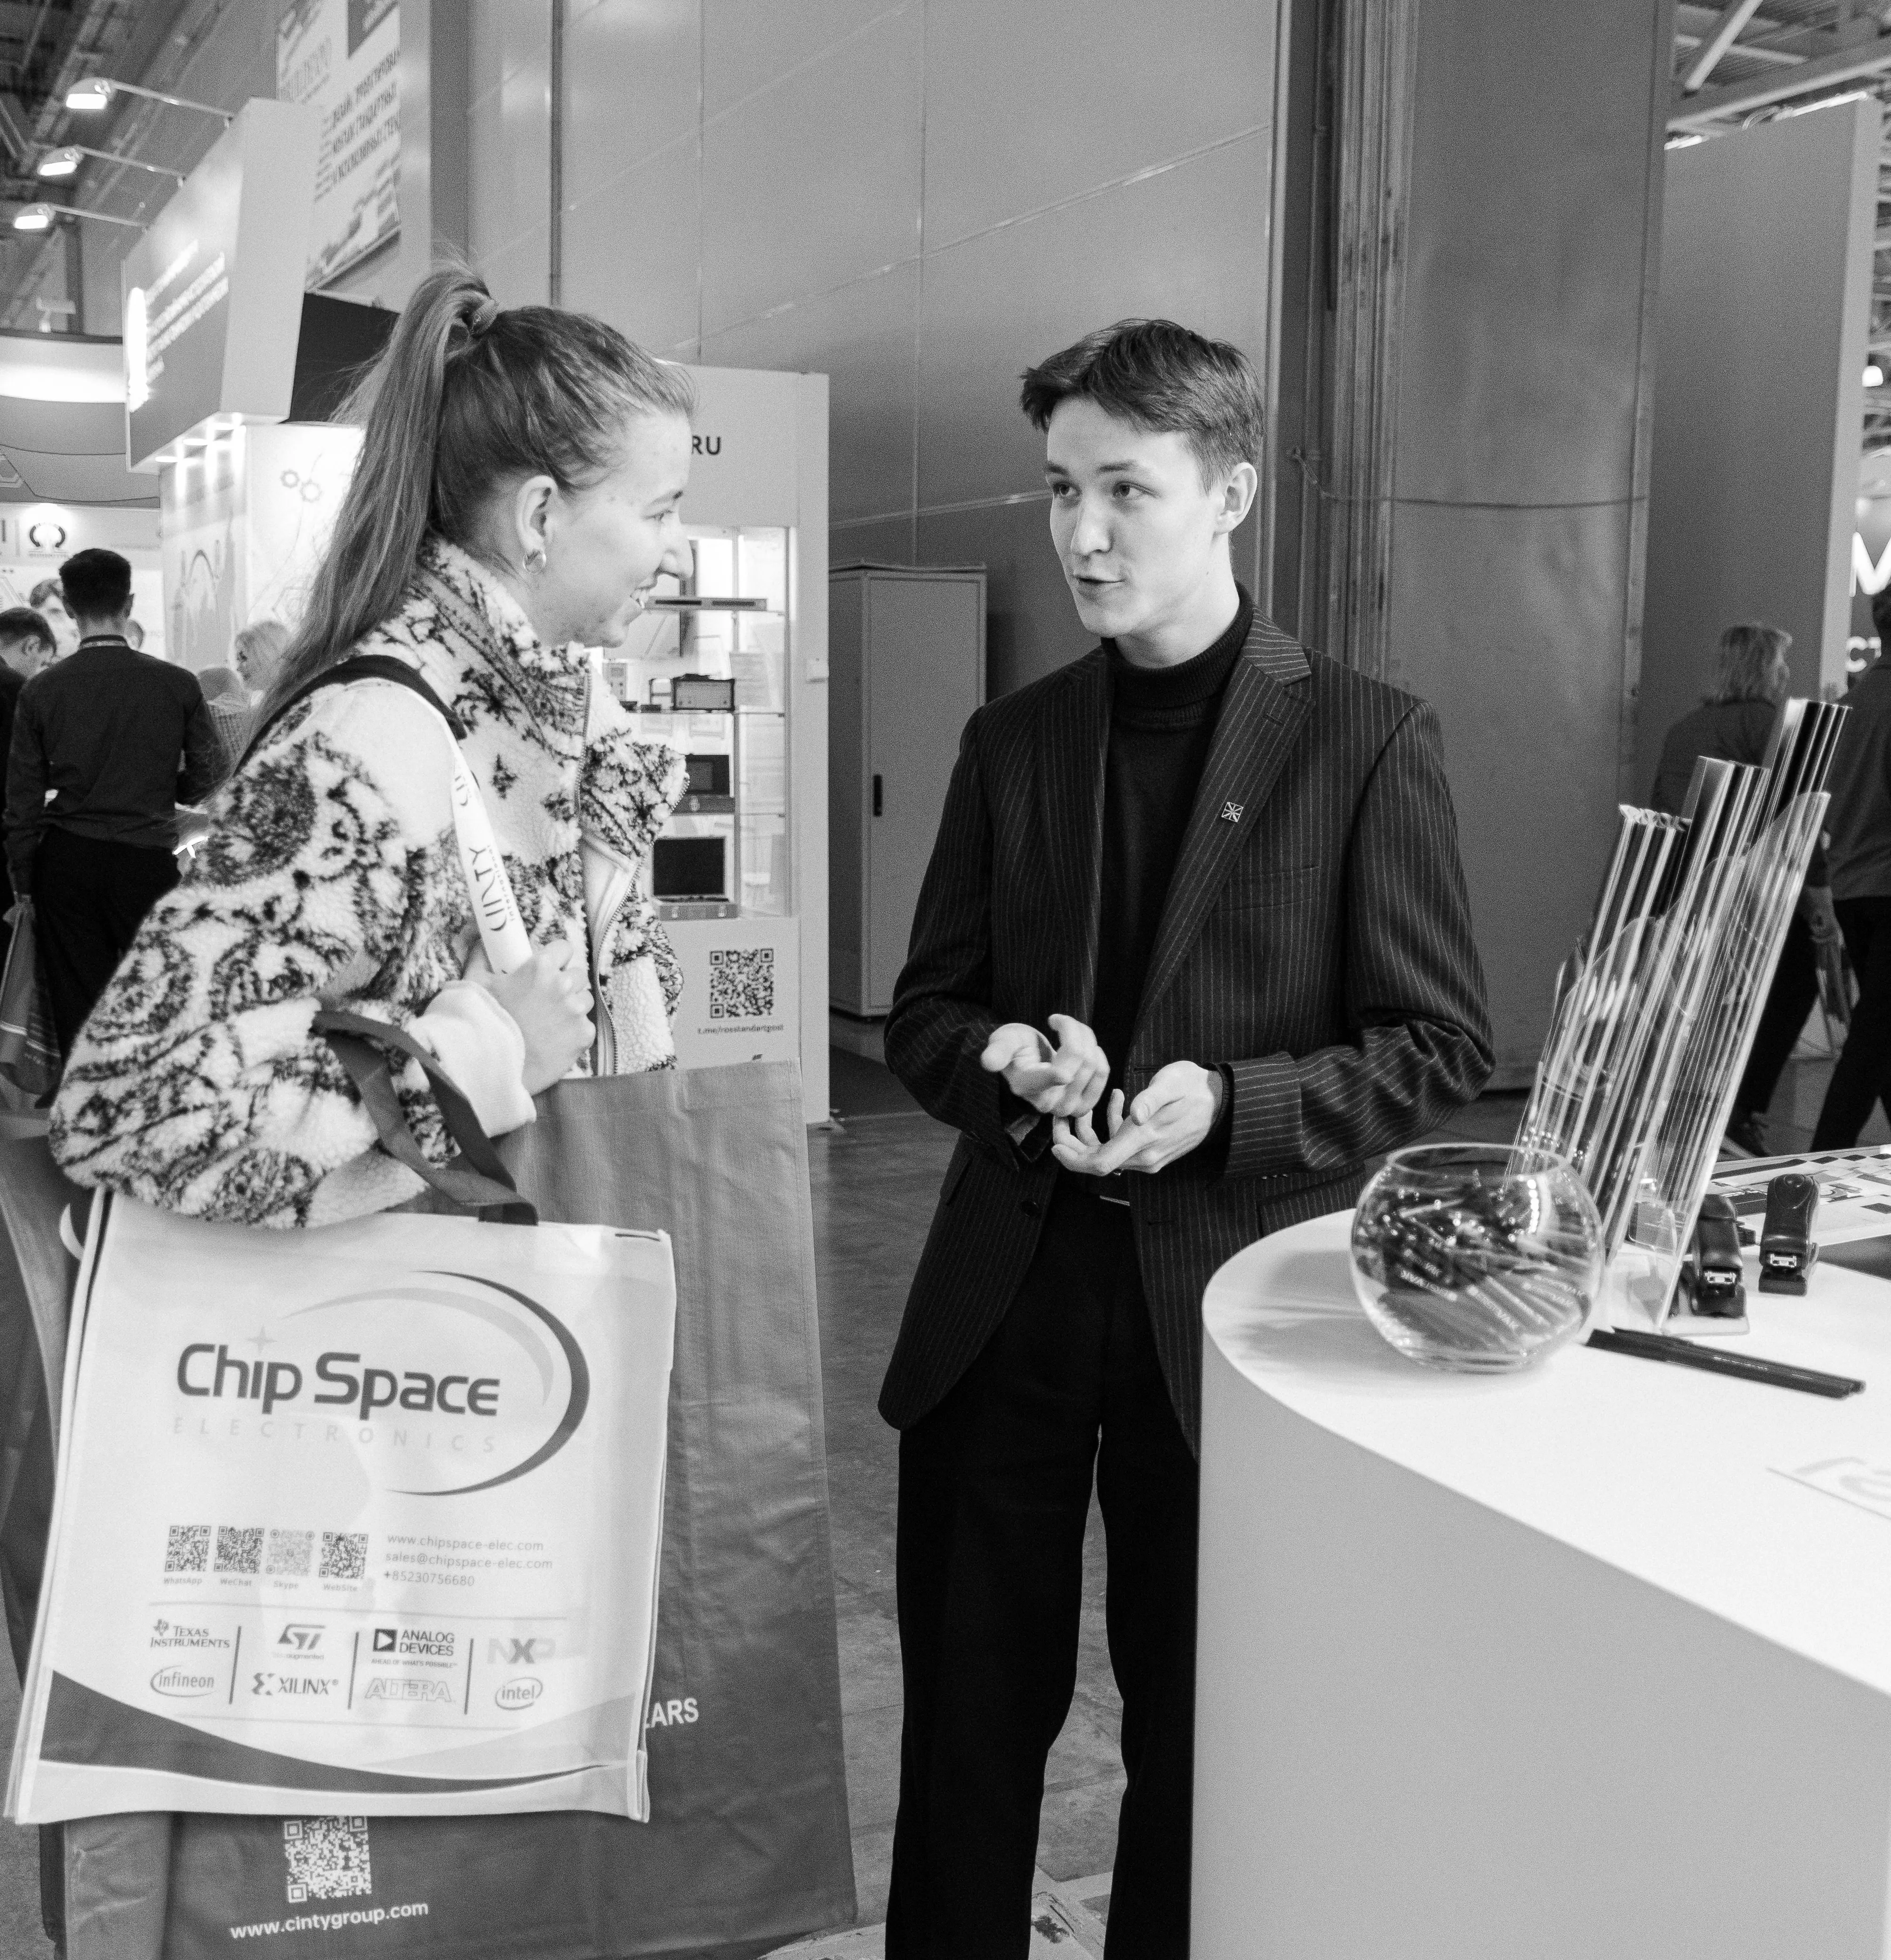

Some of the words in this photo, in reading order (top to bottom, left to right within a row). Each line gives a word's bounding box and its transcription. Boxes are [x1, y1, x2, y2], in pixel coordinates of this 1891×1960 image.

[176, 1342, 303, 1415] Chip
[314, 1351, 501, 1421] Space
[173, 1417, 495, 1454] ELECTRONICS
[387, 1535, 544, 1551] www.chipspace-elec.com
[385, 1552, 553, 1570] sales@chipspace-elec.com
[164, 1577, 202, 1586] WhatsApp
[220, 1578, 252, 1587] WeChat
[274, 1580, 299, 1590] Skype
[383, 1570, 475, 1587] +85230756680
[323, 1583, 358, 1592] WebSite
[173, 1625, 209, 1638] TEXAS
[401, 1629, 455, 1644] ANALOG
[150, 1636, 231, 1648] INSTRUMENTS
[399, 1641, 454, 1656] DEVICES
[487, 1637, 557, 1665] NXP
[158, 1671, 215, 1689] infineon
[364, 1677, 452, 1702] ALTERA
[501, 1684, 535, 1701] intel
[645, 1697, 699, 1729] ARS
[230, 1902, 429, 1939] www.cintygroup.com
